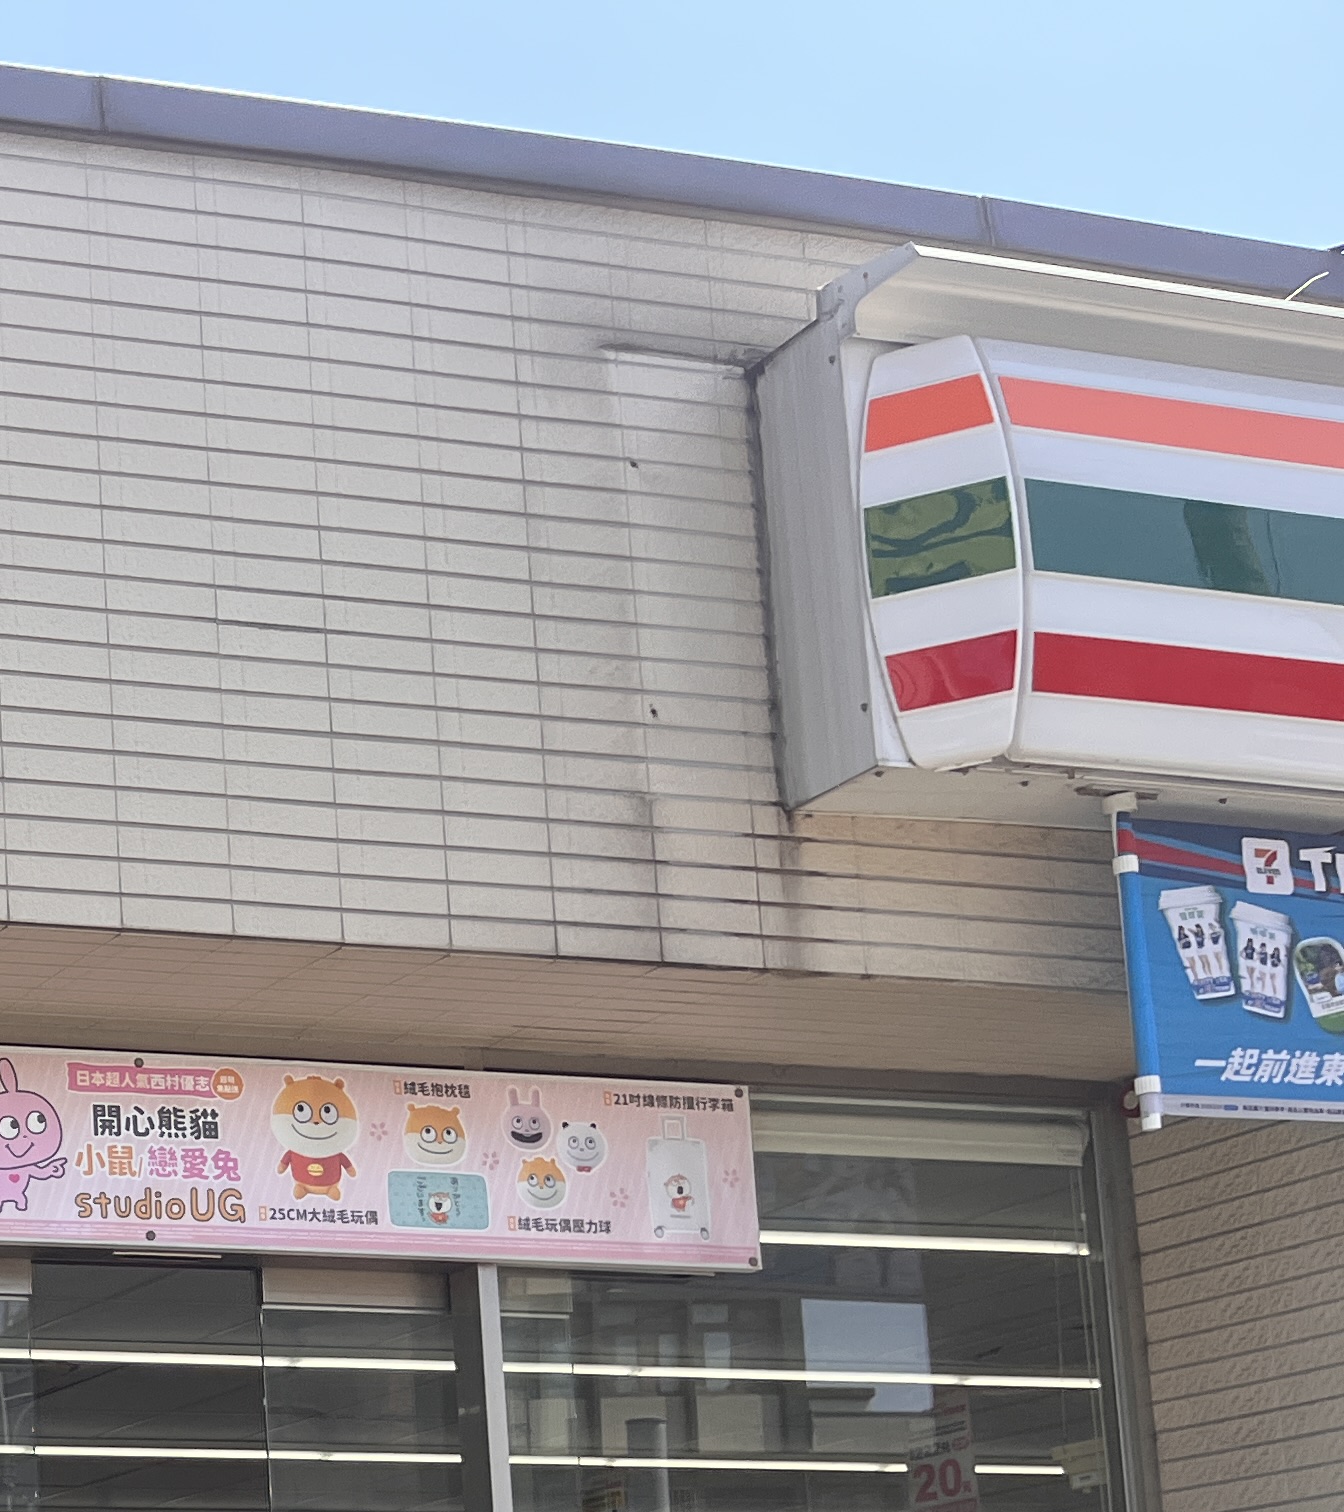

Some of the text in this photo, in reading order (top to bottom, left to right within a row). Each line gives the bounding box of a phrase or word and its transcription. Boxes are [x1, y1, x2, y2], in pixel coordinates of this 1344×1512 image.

[1300, 846, 1344, 894] T
[92, 1104, 220, 1140] 開心熊貓
